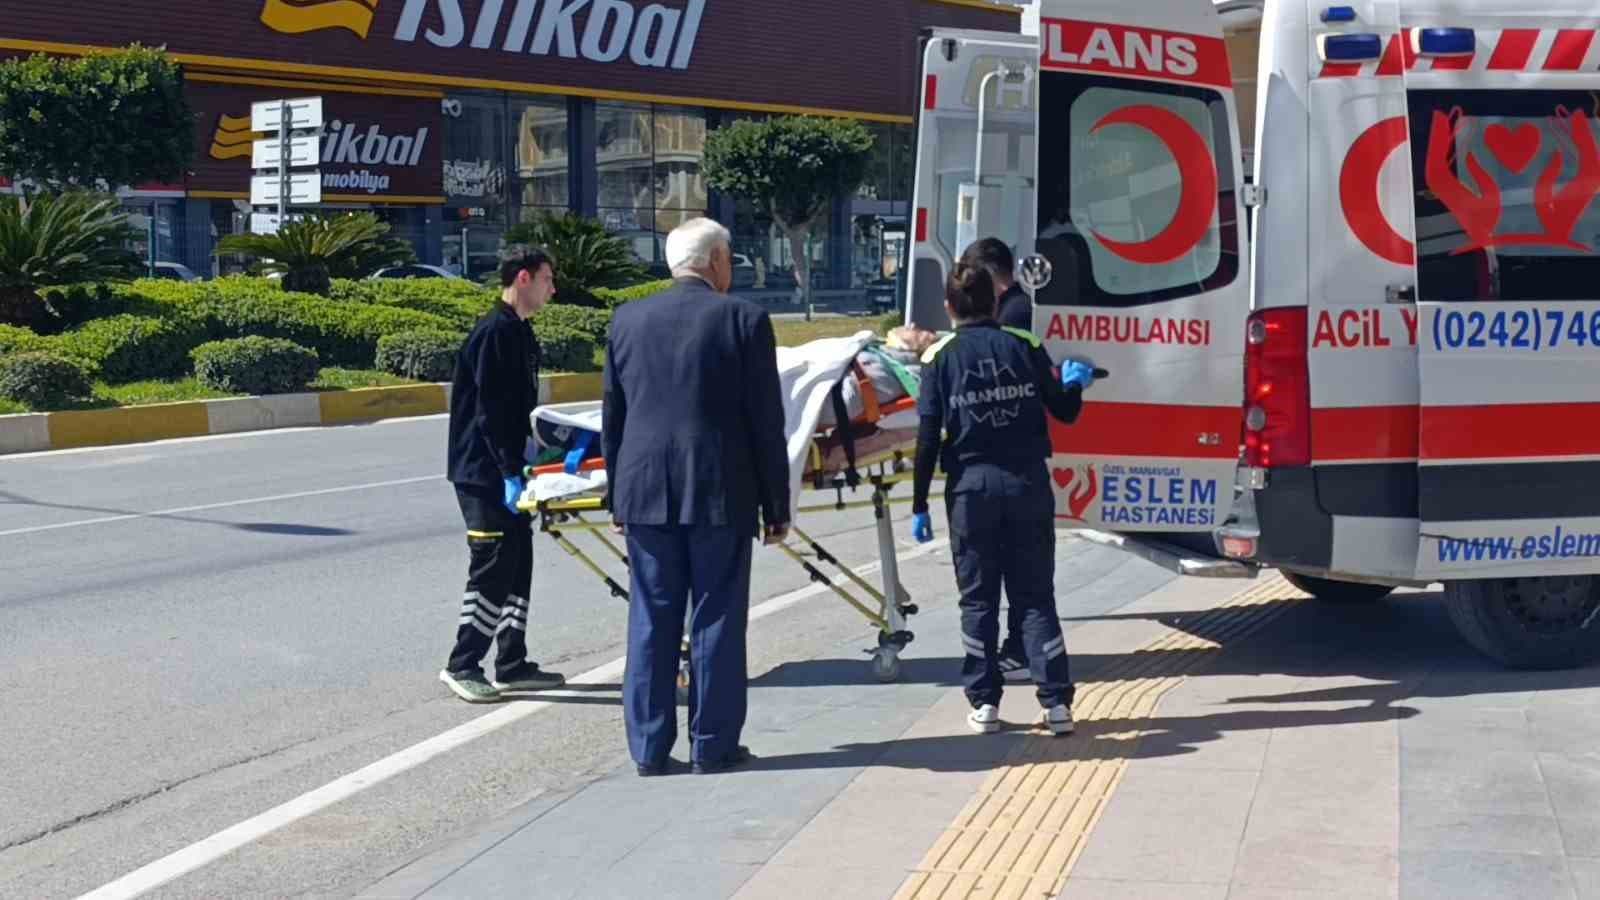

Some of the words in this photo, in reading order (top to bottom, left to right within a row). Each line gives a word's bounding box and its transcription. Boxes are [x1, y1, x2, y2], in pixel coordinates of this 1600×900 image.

[1045, 313, 1210, 346] AMBULANSI
[949, 382, 1036, 408] PARAMEDIC
[1103, 476, 1216, 504] ESLEM
[1438, 526, 1600, 562] www.eslem
